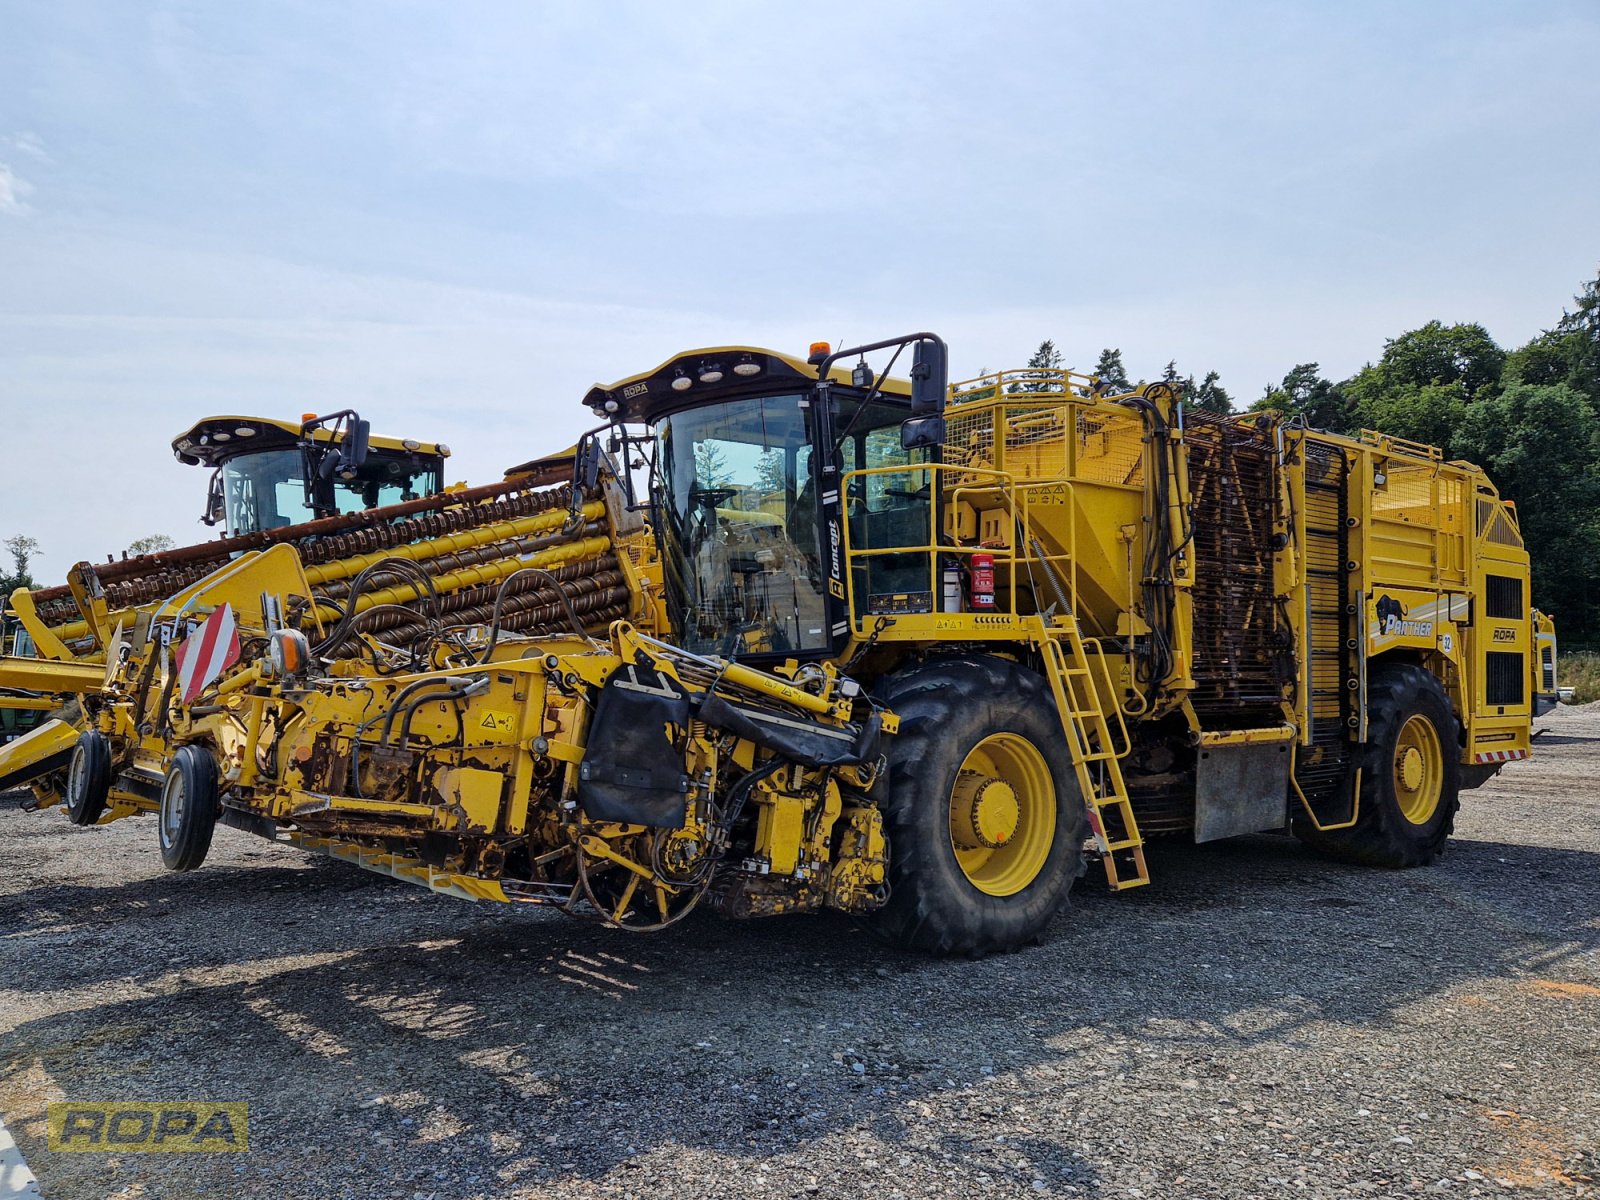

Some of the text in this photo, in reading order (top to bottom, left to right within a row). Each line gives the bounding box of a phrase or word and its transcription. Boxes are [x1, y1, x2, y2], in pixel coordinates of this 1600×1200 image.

[624, 383, 648, 397] ROPA
[829, 519, 840, 580] Concept
[1493, 630, 1516, 640] ROPA
[1444, 637, 1451, 650] 32
